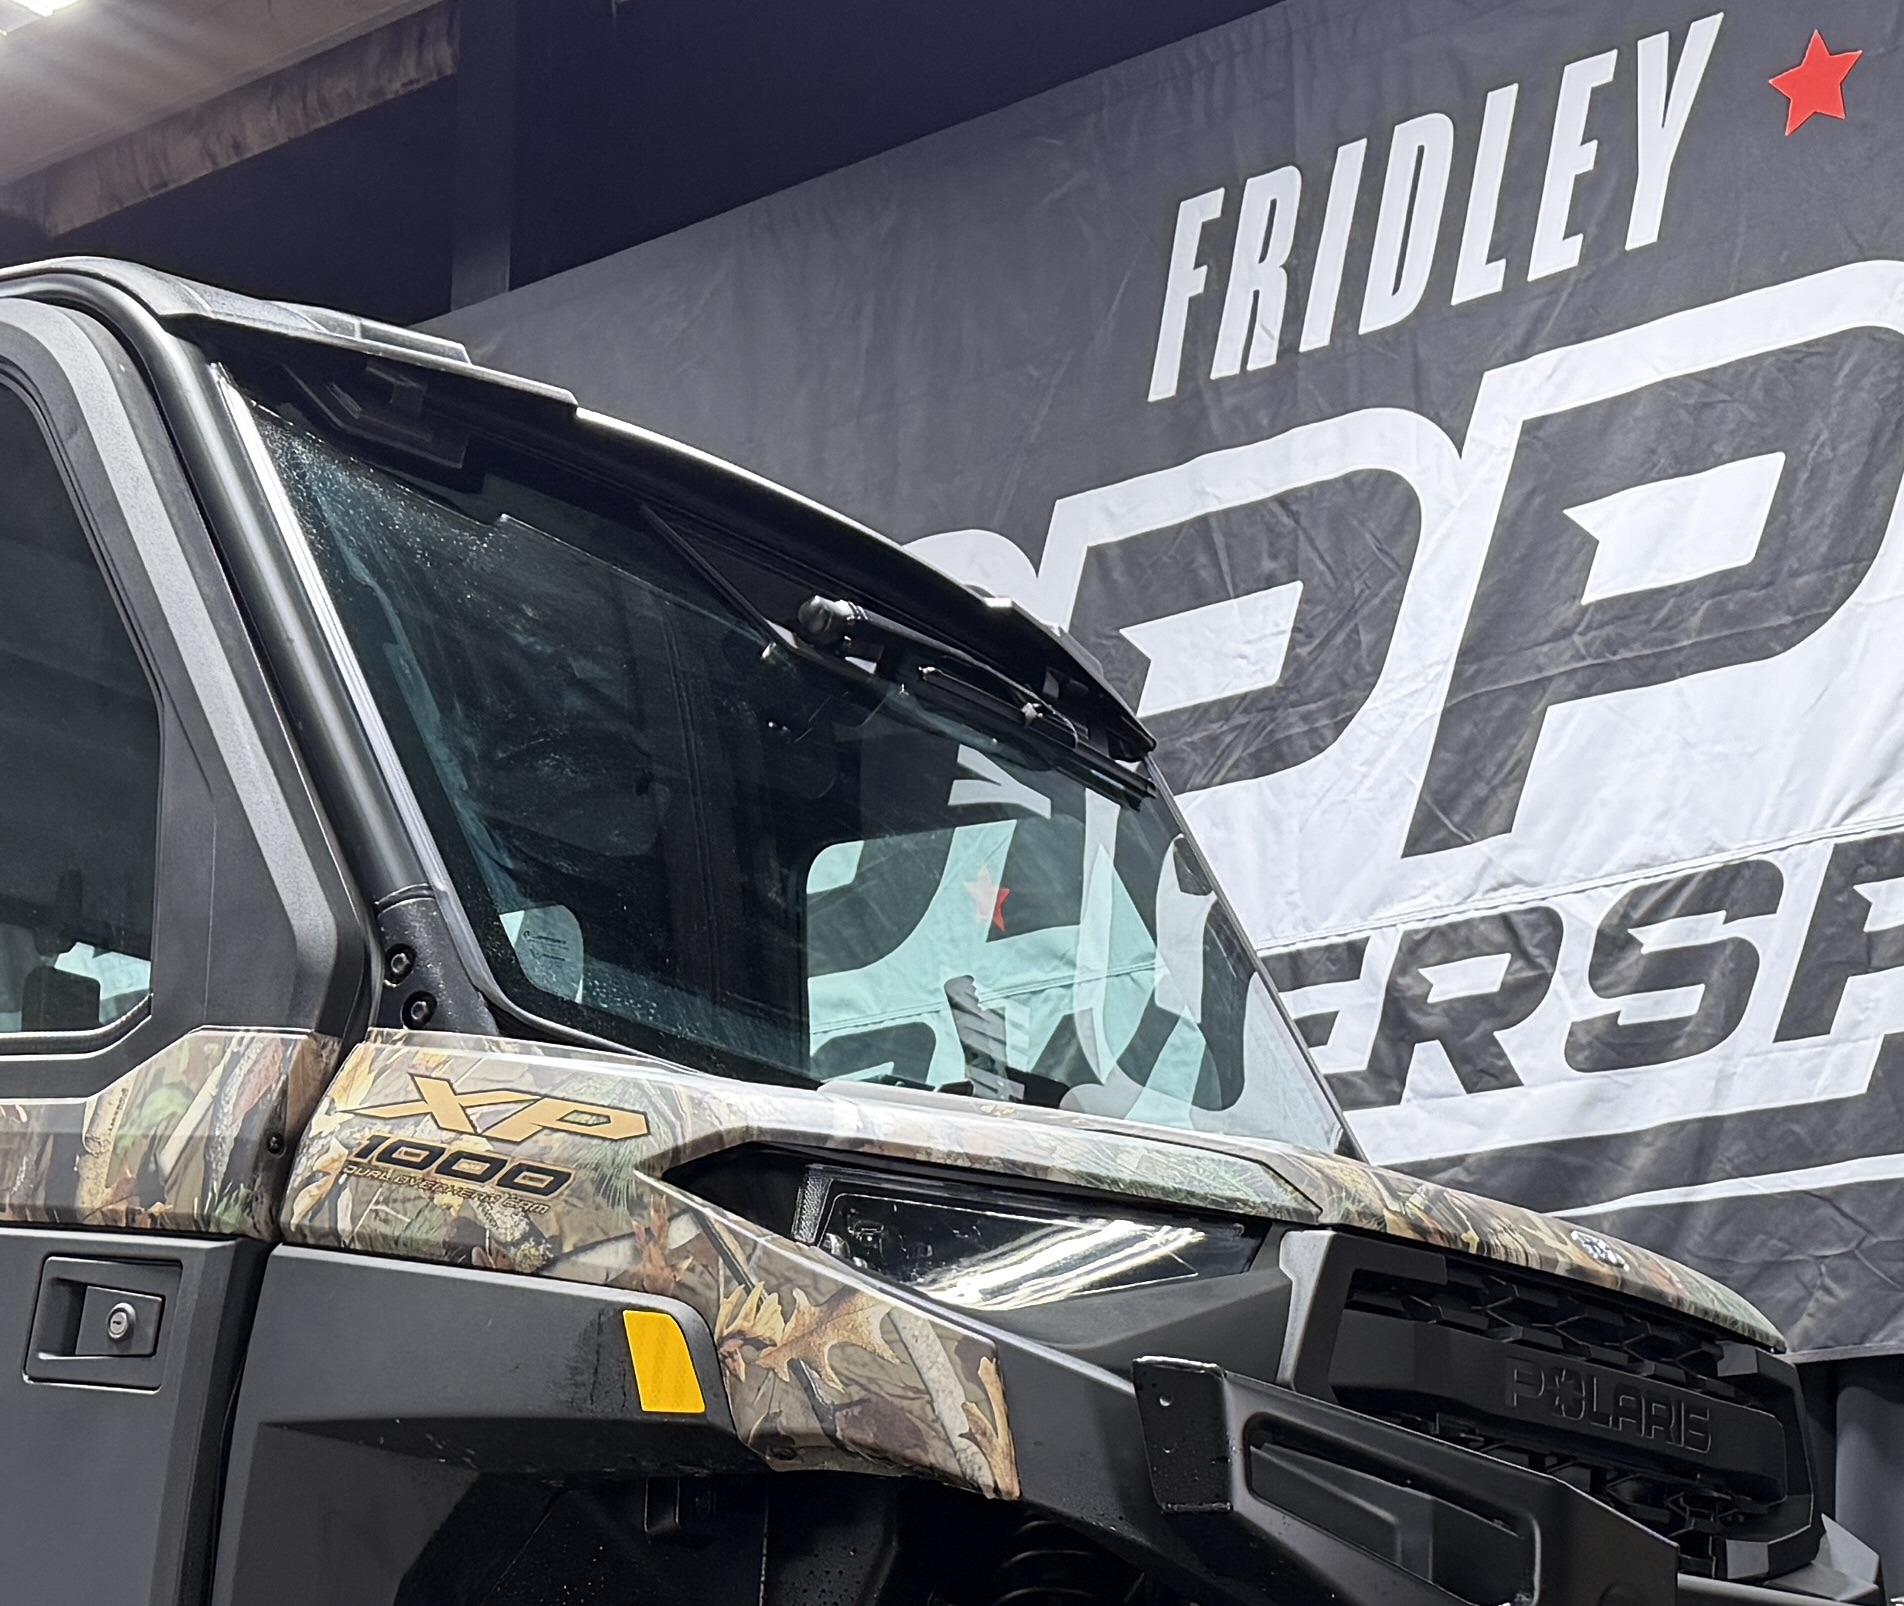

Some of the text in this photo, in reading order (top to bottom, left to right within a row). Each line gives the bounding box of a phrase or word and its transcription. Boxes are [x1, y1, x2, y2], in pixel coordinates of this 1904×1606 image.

[1148, 15, 1722, 402] FRIDLEY
[337, 1073, 651, 1145] XP
[343, 1164, 391, 1181] DUAL
[350, 1133, 574, 1197] 1000
[1505, 1357, 1712, 1454] POLARIS
